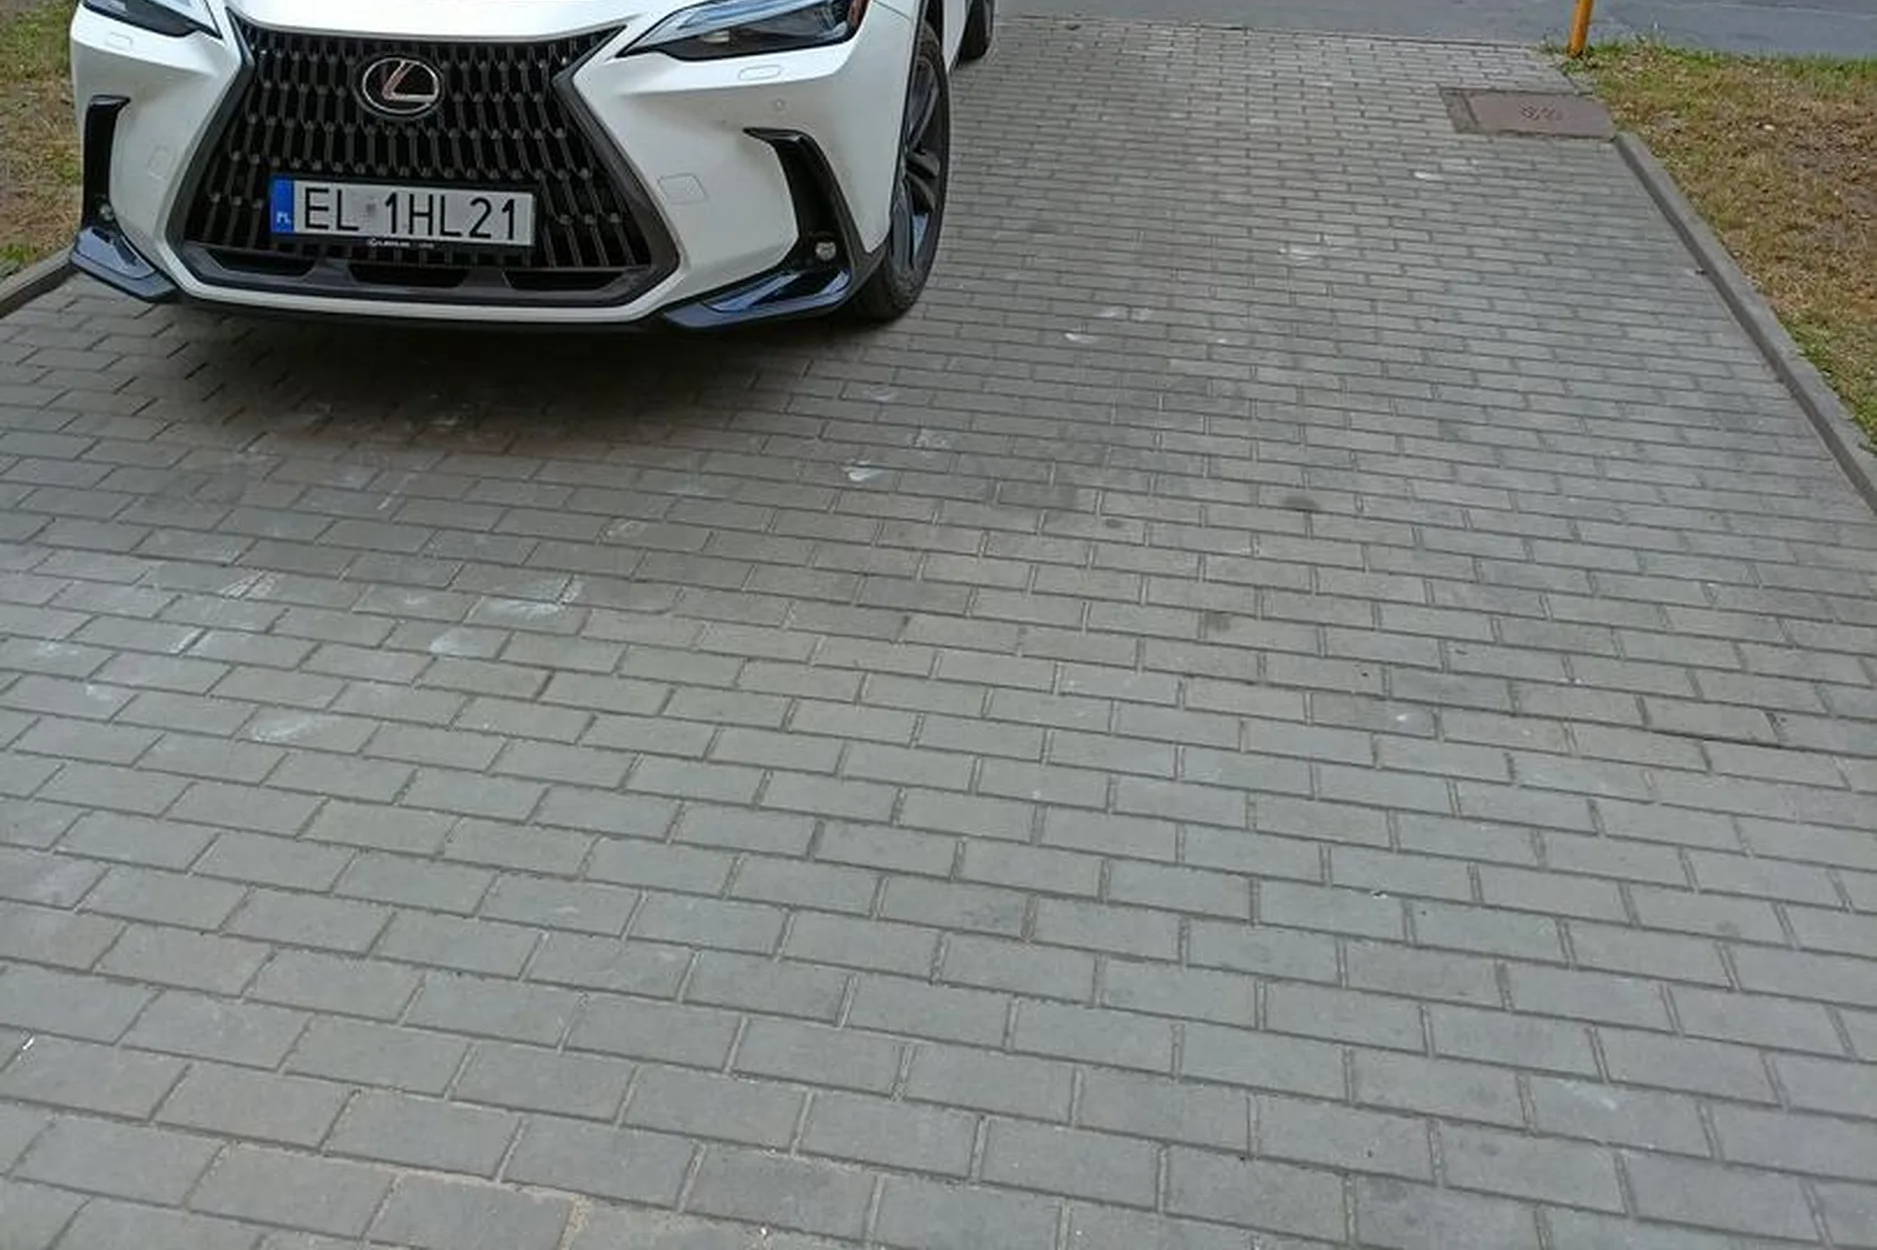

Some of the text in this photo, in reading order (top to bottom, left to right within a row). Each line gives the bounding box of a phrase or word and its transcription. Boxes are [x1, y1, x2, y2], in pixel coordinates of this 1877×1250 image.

[276, 211, 292, 225] PL
[304, 186, 516, 241] EL 1HL21
